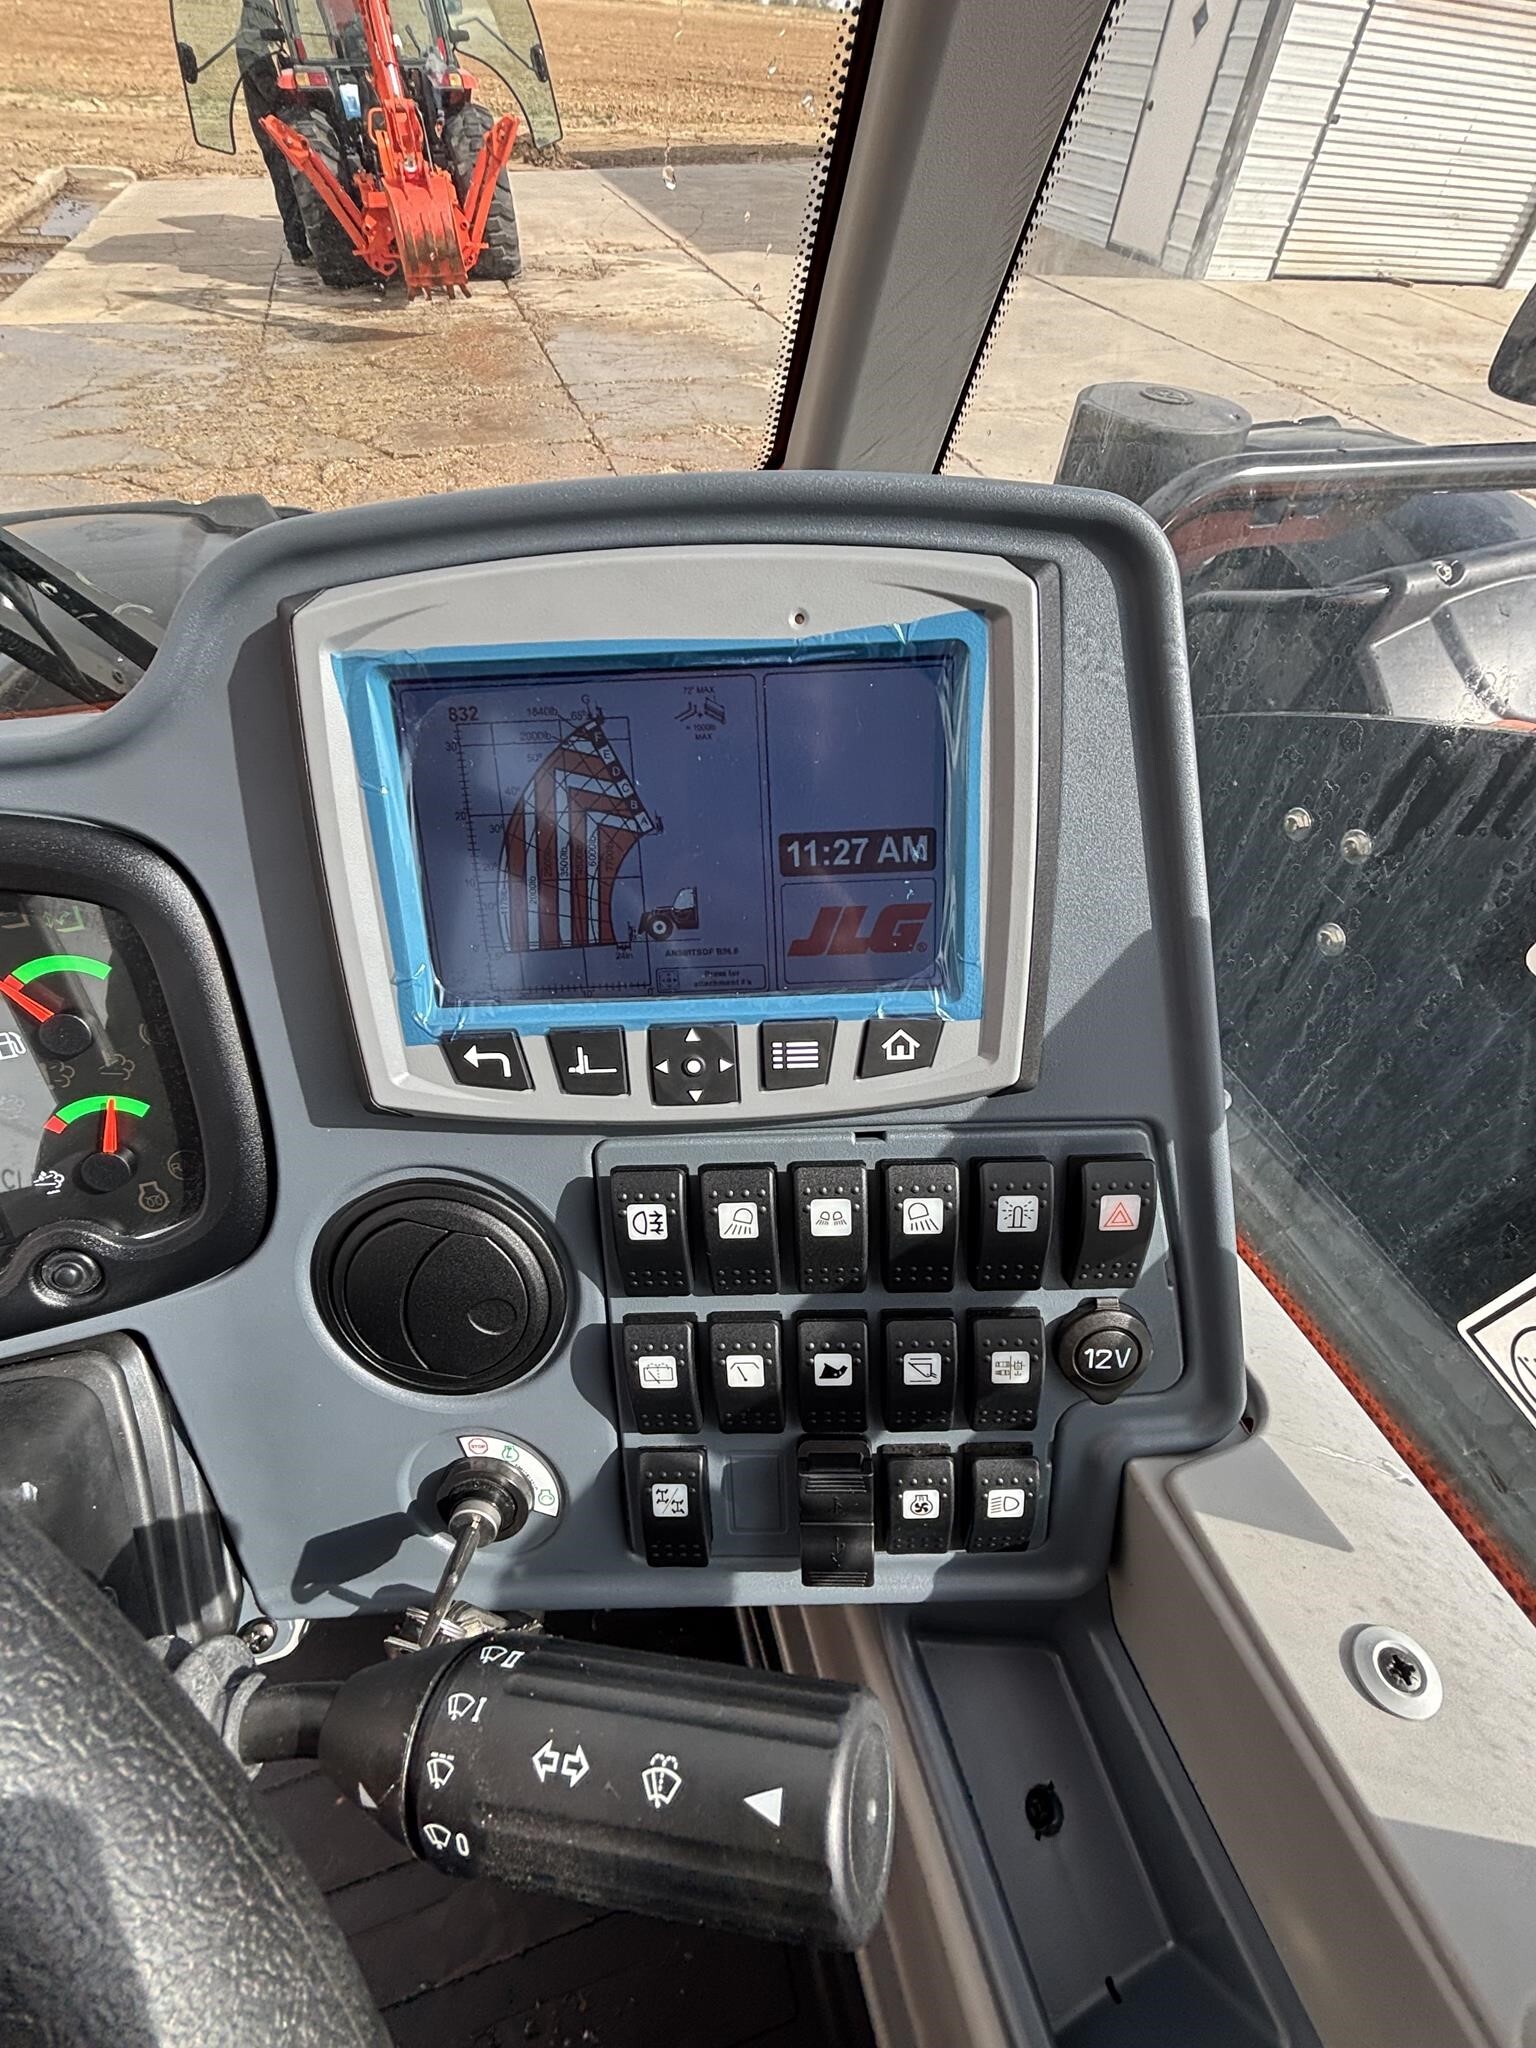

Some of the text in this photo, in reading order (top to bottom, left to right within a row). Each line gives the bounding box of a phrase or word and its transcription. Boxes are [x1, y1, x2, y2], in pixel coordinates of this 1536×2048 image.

[581, 694, 590, 704] G
[448, 706, 478, 722] 832
[594, 732, 601, 742] F
[603, 749, 611, 759] E
[612, 766, 621, 776] D
[621, 783, 630, 793] C
[630, 800, 638, 809] B
[641, 817, 649, 827] A
[787, 835, 928, 868] 11:27 AM
[560, 847, 569, 877] 3500lb
[1083, 1347, 1132, 1369] 12V
